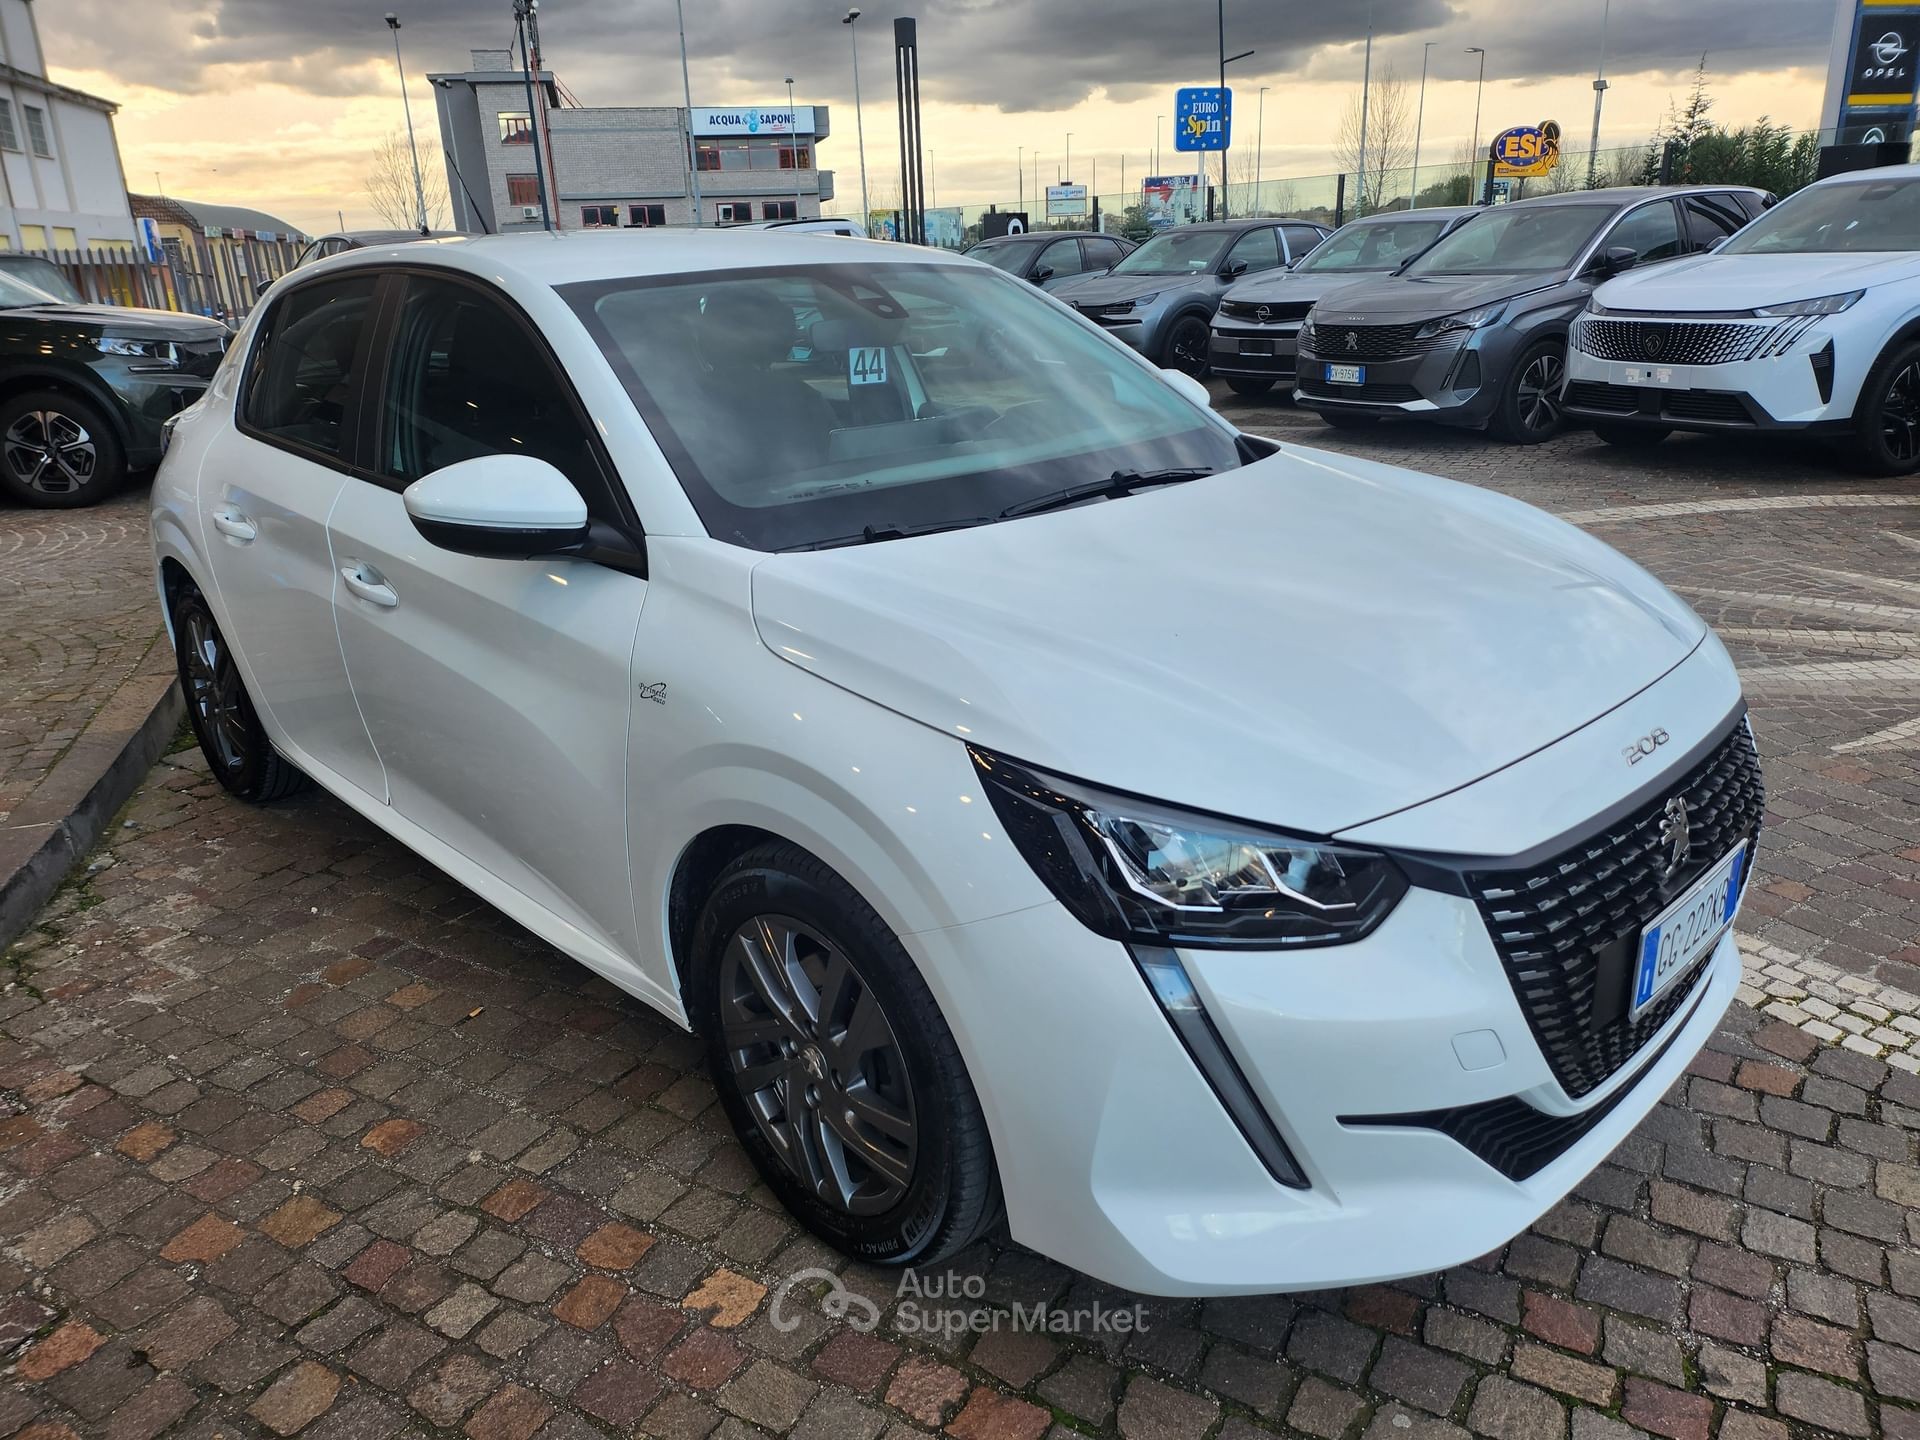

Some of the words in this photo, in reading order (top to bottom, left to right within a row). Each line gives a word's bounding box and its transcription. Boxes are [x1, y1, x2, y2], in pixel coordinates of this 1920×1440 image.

[1864, 68, 1905, 77] OPEL
[1192, 102, 1219, 114] EURO
[709, 115, 741, 125] ACQUA
[759, 113, 796, 124] SAPONE
[1187, 114, 1221, 138] Spin
[1504, 133, 1544, 158] ESI
[853, 349, 884, 382] 44
[1621, 727, 1670, 767] 208
[860, 1237, 899, 1254] PRIMACY
